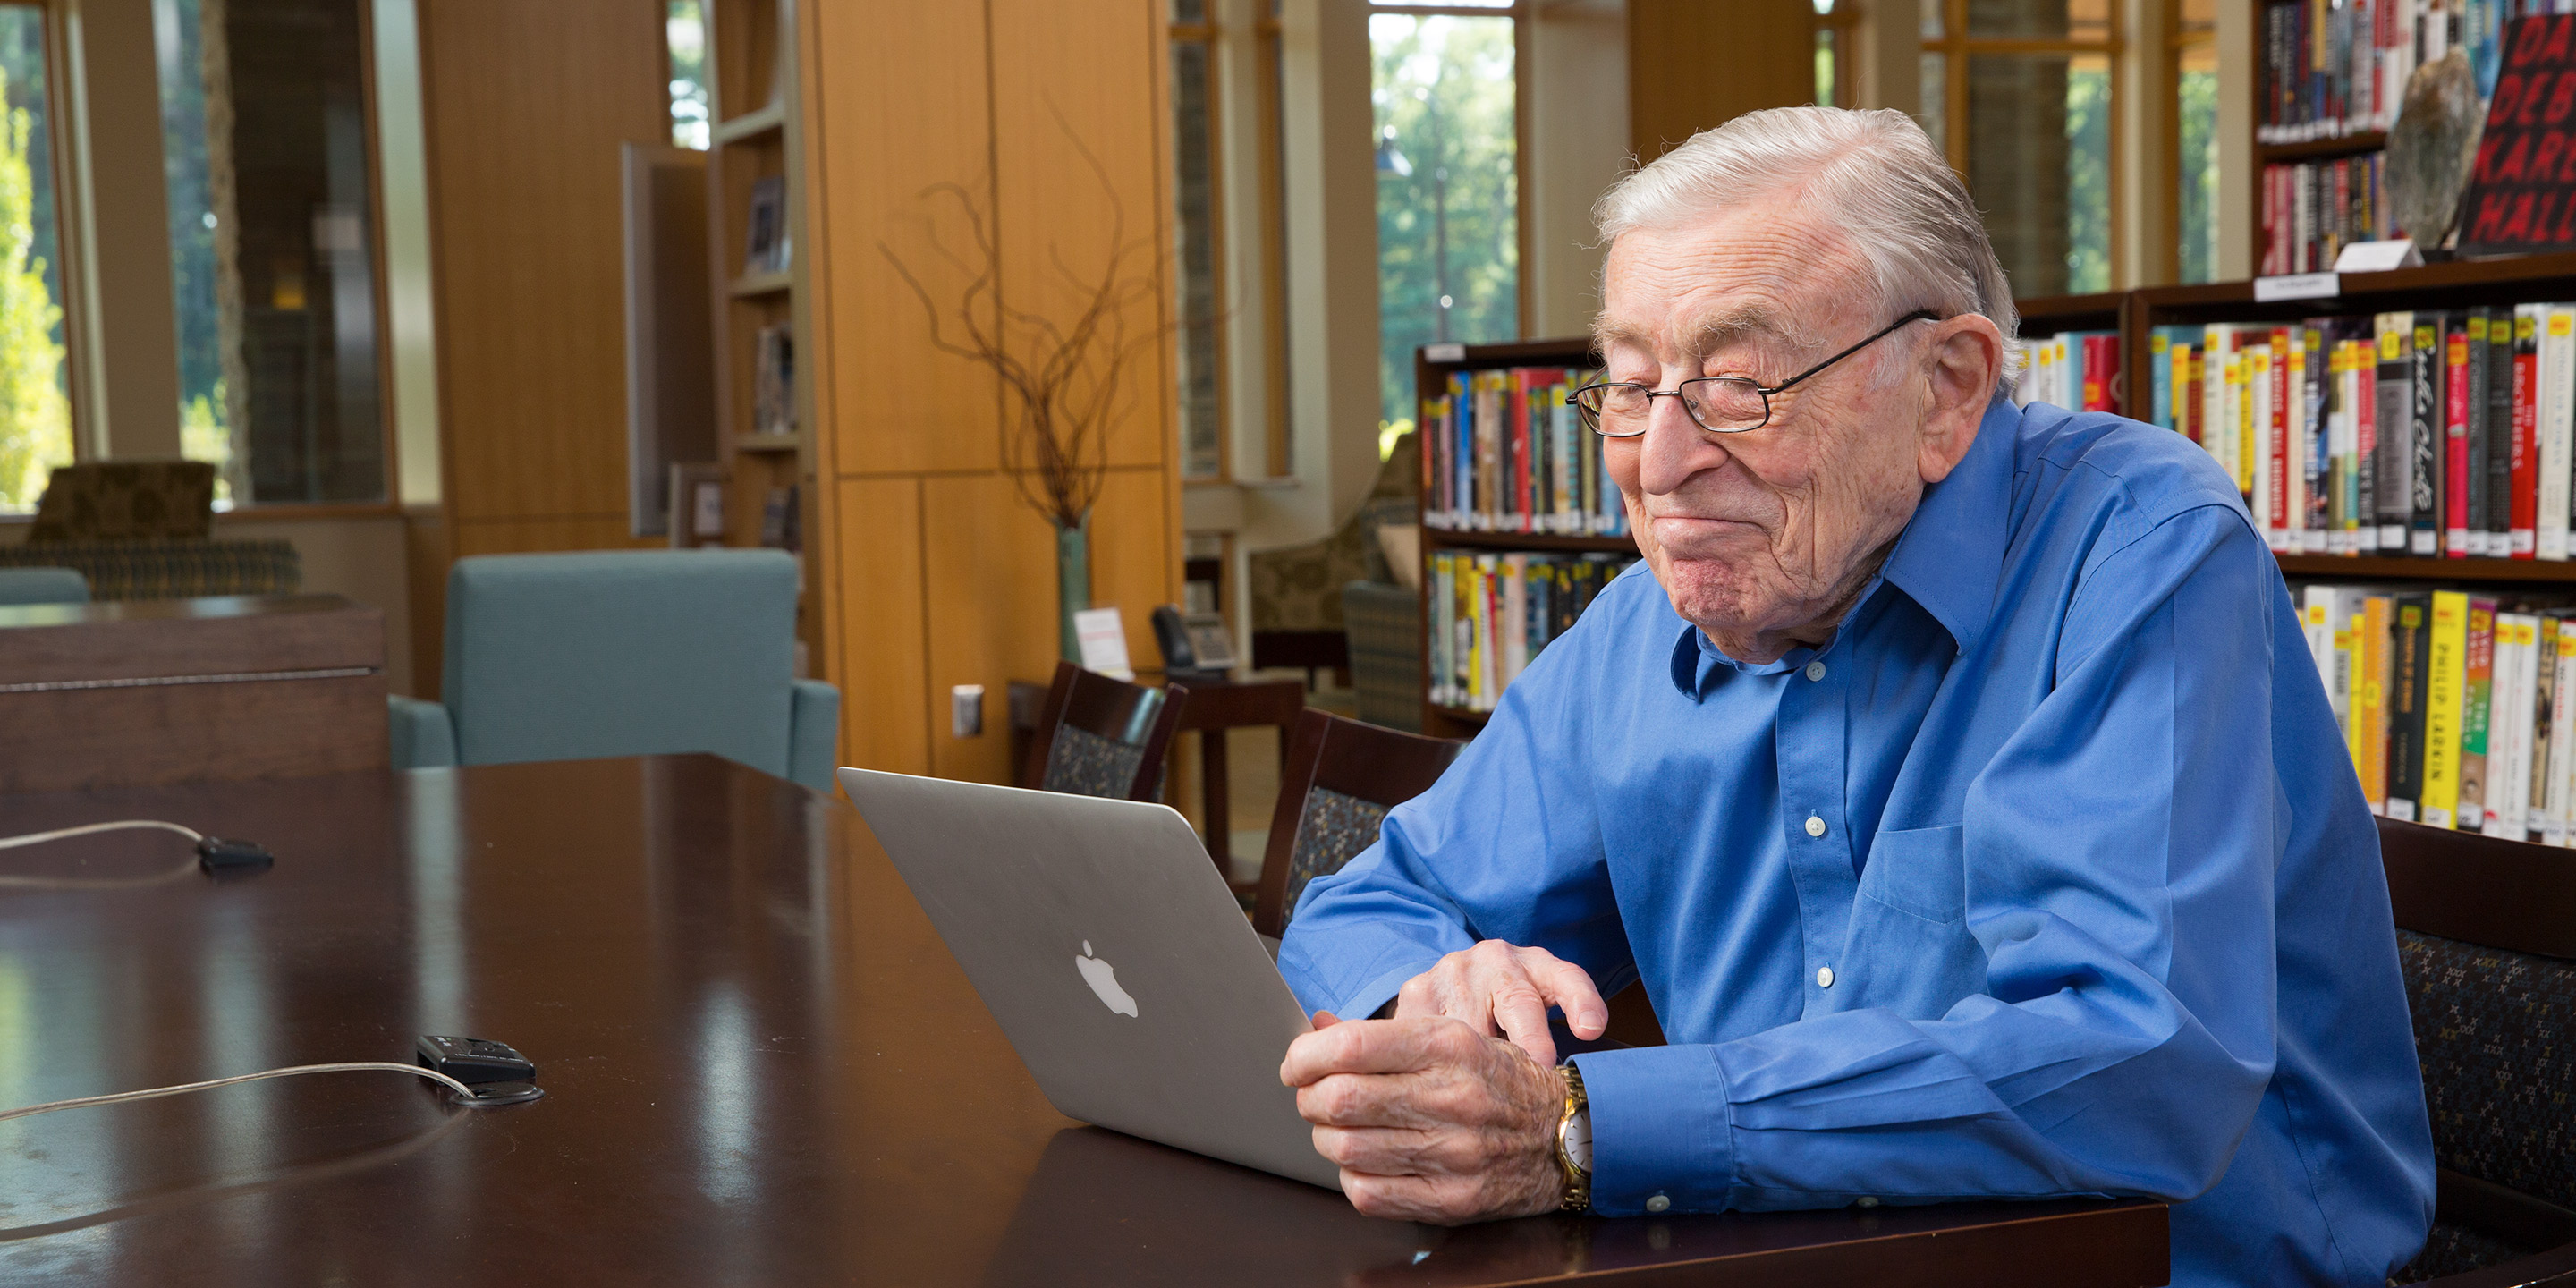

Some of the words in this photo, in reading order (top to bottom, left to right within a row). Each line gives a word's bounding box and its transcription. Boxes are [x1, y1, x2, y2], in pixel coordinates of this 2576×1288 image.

[2510, 13, 2576, 67] DA
[2487, 71, 2576, 126] DEB
[2468, 191, 2576, 242] HALL
[2512, 362, 2526, 470] BROTHERS
[2435, 643, 2450, 705] PHILIP
[2478, 630, 2490, 667] AVID
[2431, 714, 2447, 782] LARKIN
